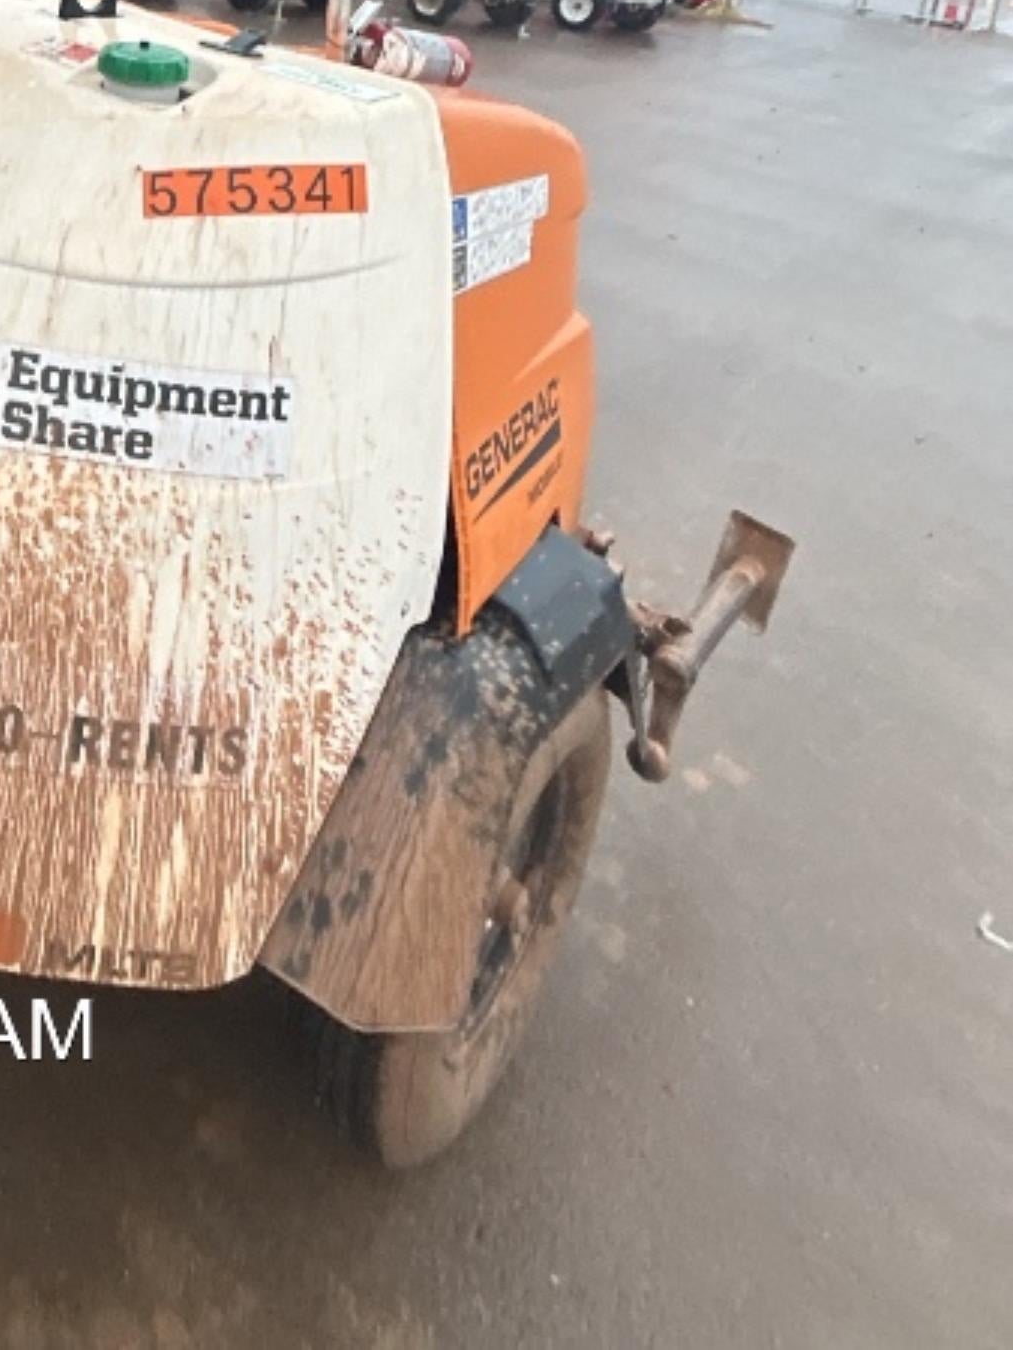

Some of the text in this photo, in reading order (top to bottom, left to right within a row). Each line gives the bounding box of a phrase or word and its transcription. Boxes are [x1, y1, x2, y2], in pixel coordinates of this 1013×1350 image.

[148, 166, 358, 216] 575341
[7, 349, 291, 422] Equipment
[1, 401, 154, 460] Share
[464, 377, 561, 500] GENERAC
